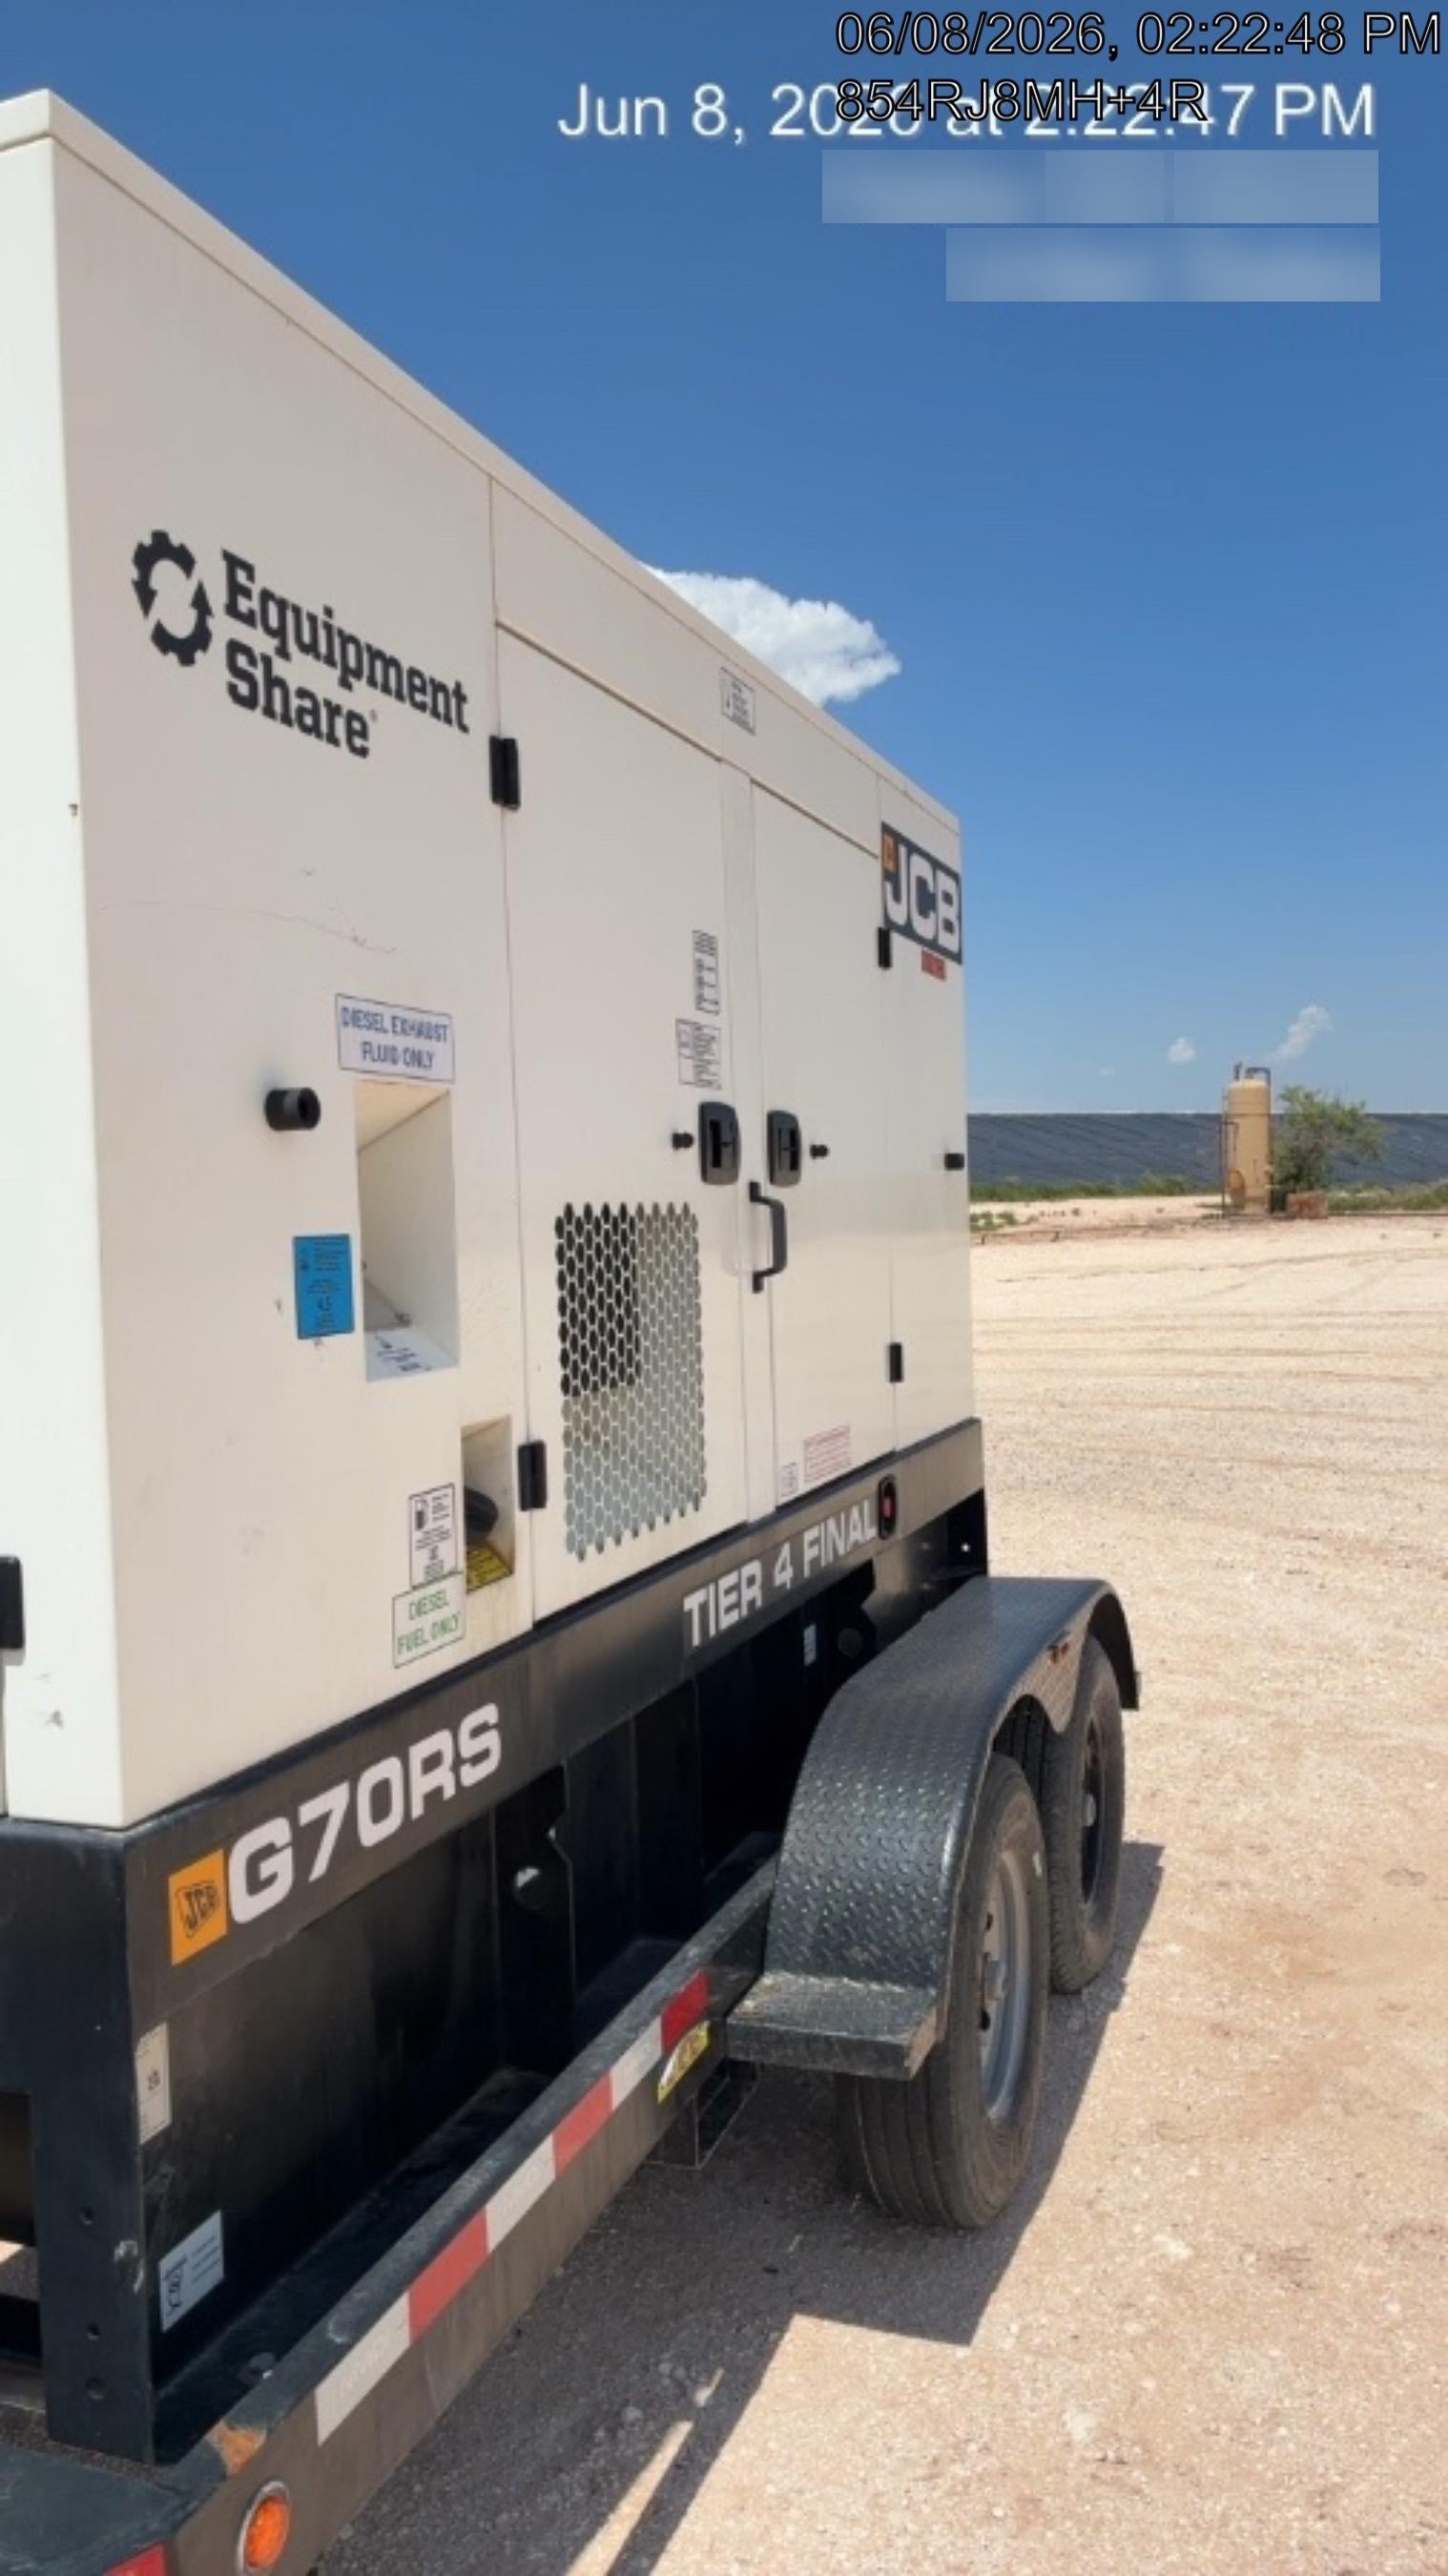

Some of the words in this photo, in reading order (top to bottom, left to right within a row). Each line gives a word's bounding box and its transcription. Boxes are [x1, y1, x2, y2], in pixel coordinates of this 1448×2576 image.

[221, 547, 469, 735] Equipment
[225, 636, 371, 759] Share
[885, 843, 962, 954] JCB
[341, 1006, 389, 1034] DIESEL
[361, 1040, 400, 1066] FLUID
[402, 1046, 436, 1070] ONLY
[408, 1588, 450, 1620] DIESEL
[683, 1559, 762, 1648] TIER
[773, 1541, 794, 1590] 4
[803, 1499, 878, 1579] FINAL
[229, 1703, 502, 1924] G70RS
